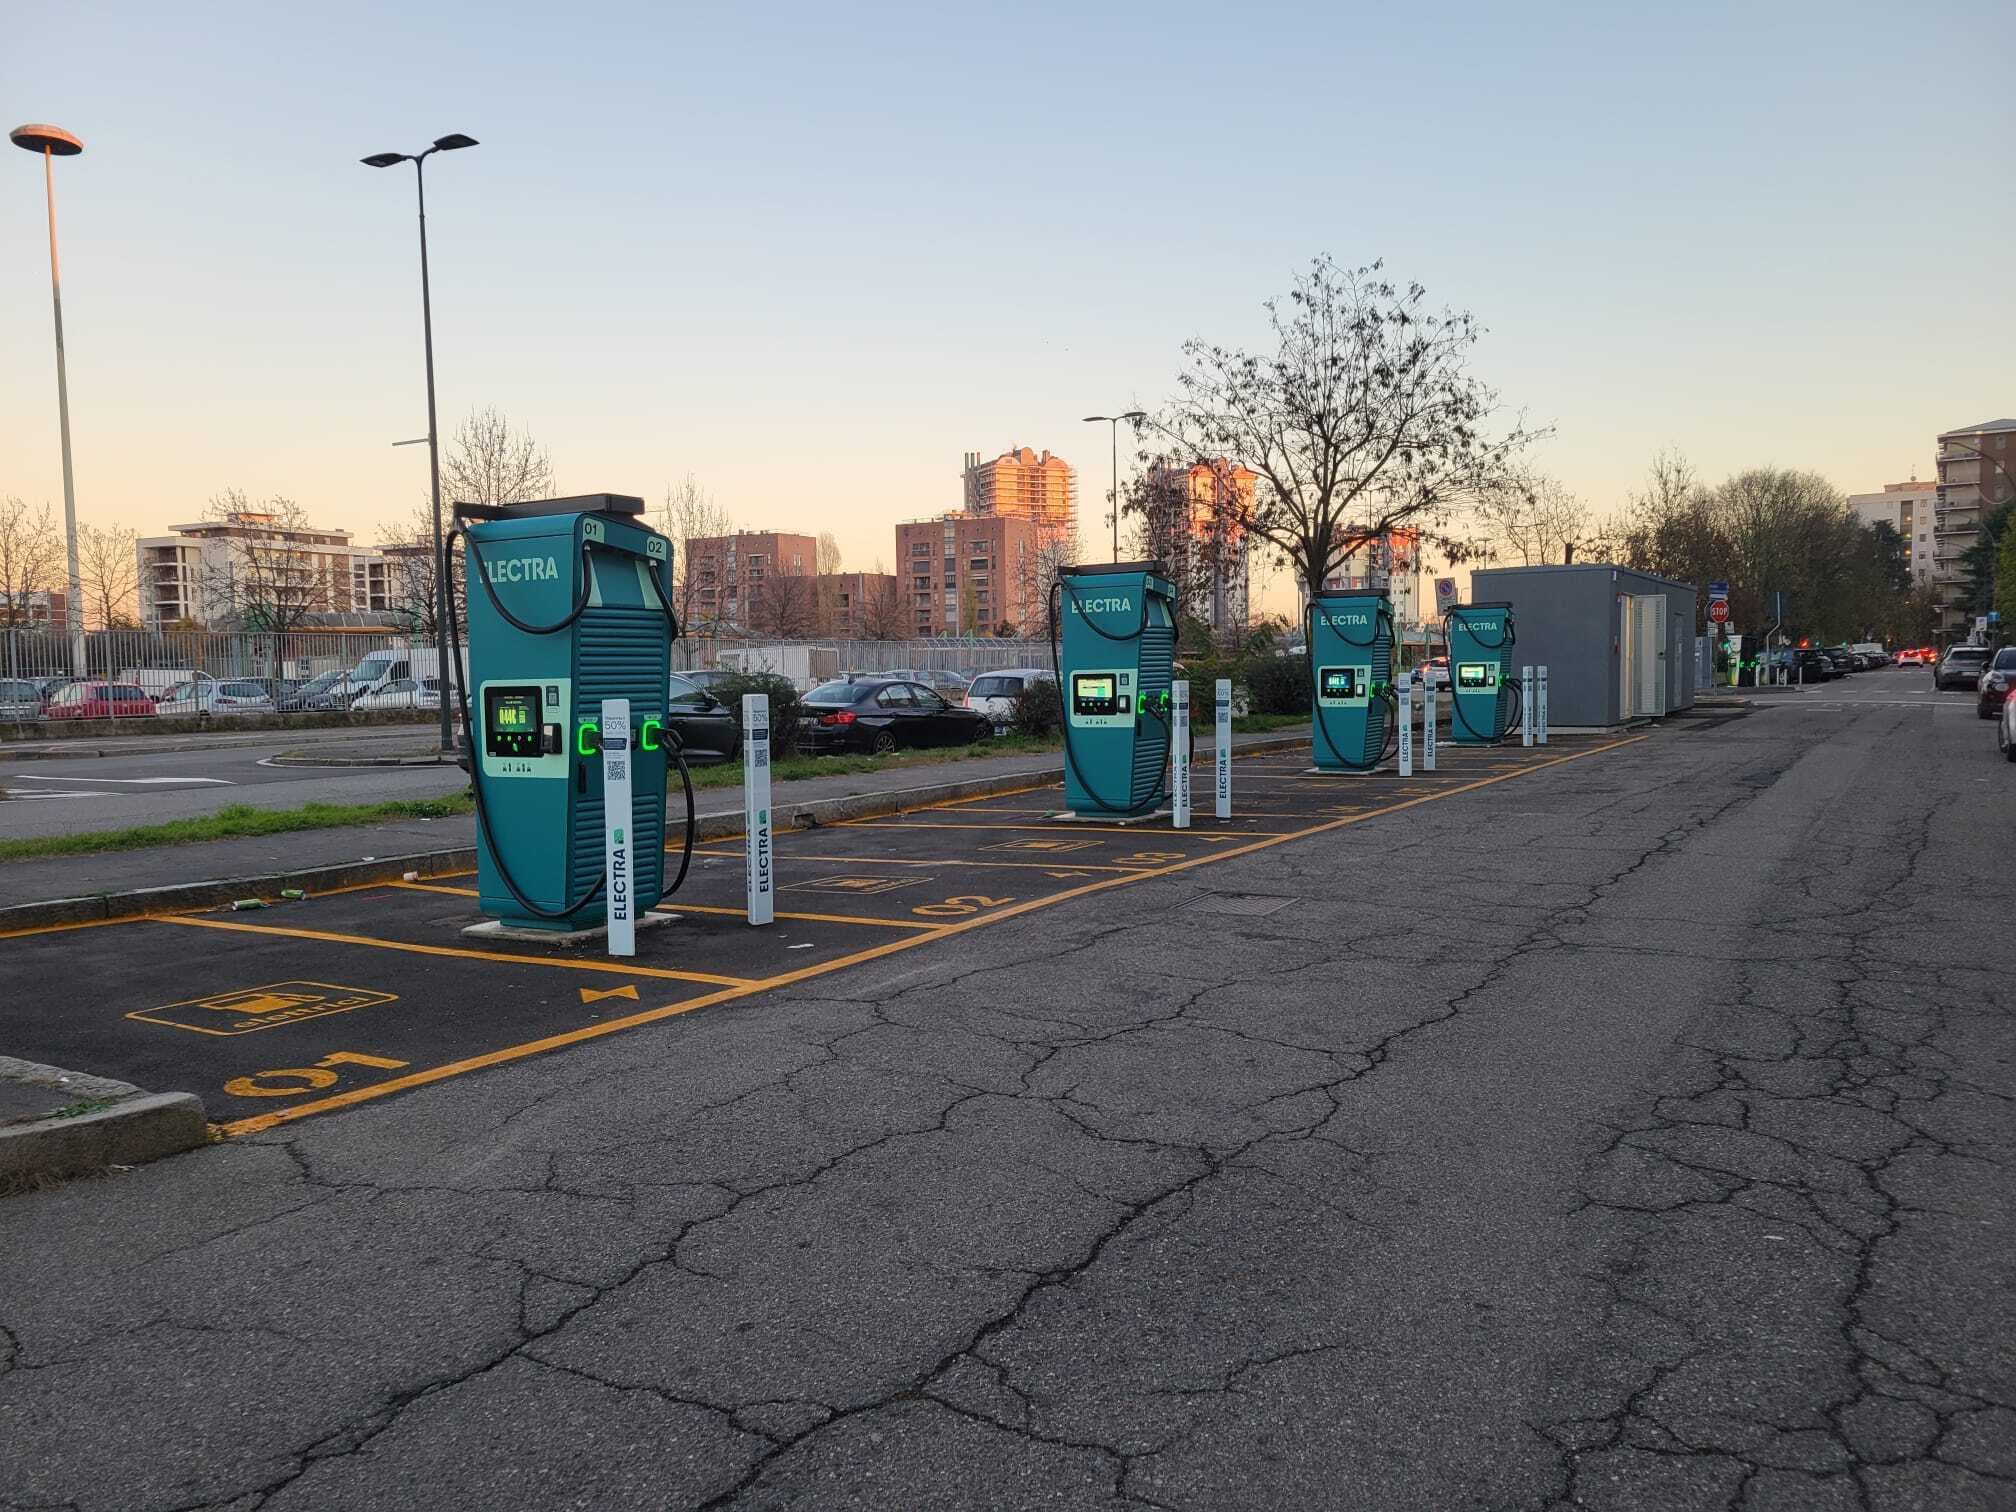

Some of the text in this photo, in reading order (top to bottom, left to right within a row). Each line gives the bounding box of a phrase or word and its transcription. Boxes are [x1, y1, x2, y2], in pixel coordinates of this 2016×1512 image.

[584, 522, 597, 536] 01
[648, 541, 662, 553] 02
[480, 557, 559, 584] LECTRA
[1711, 607, 1728, 616] STOP
[1458, 622, 1498, 632] ELECTRA
[605, 720, 626, 730] 50%
[1219, 760, 1227, 799] ELECTRA
[759, 828, 769, 893] ELECTRA
[613, 848, 627, 921] ELECTRA
[912, 895, 1017, 916] 02
[223, 1051, 411, 1097] 01
